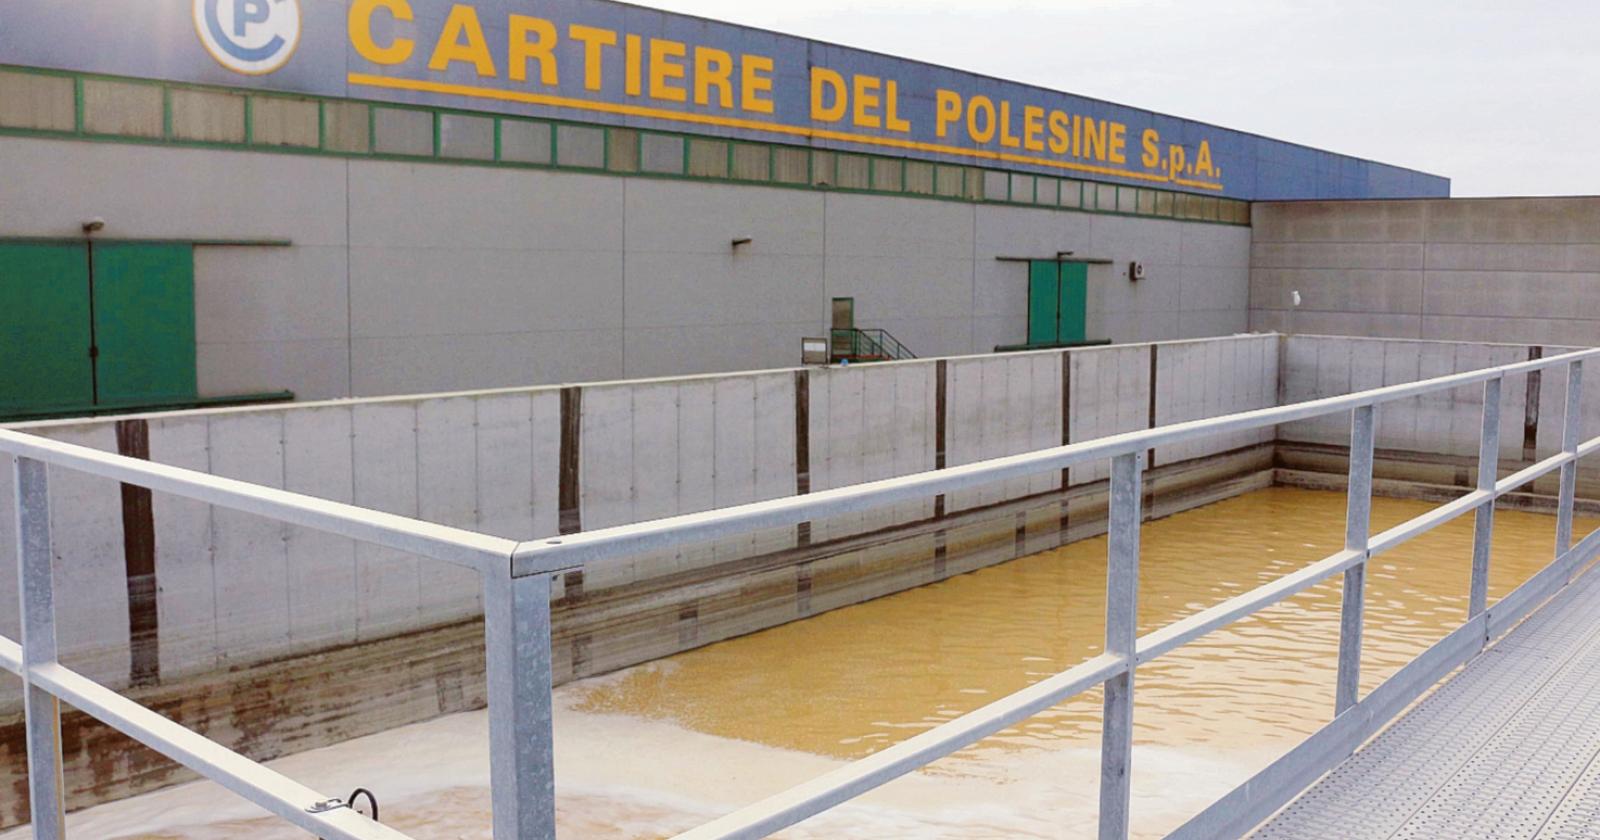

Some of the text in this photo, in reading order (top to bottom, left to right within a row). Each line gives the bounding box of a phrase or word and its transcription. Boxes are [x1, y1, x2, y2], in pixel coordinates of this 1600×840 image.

[348, 0, 1222, 178] CARTIERE DEL POLESINE S.p.A.
